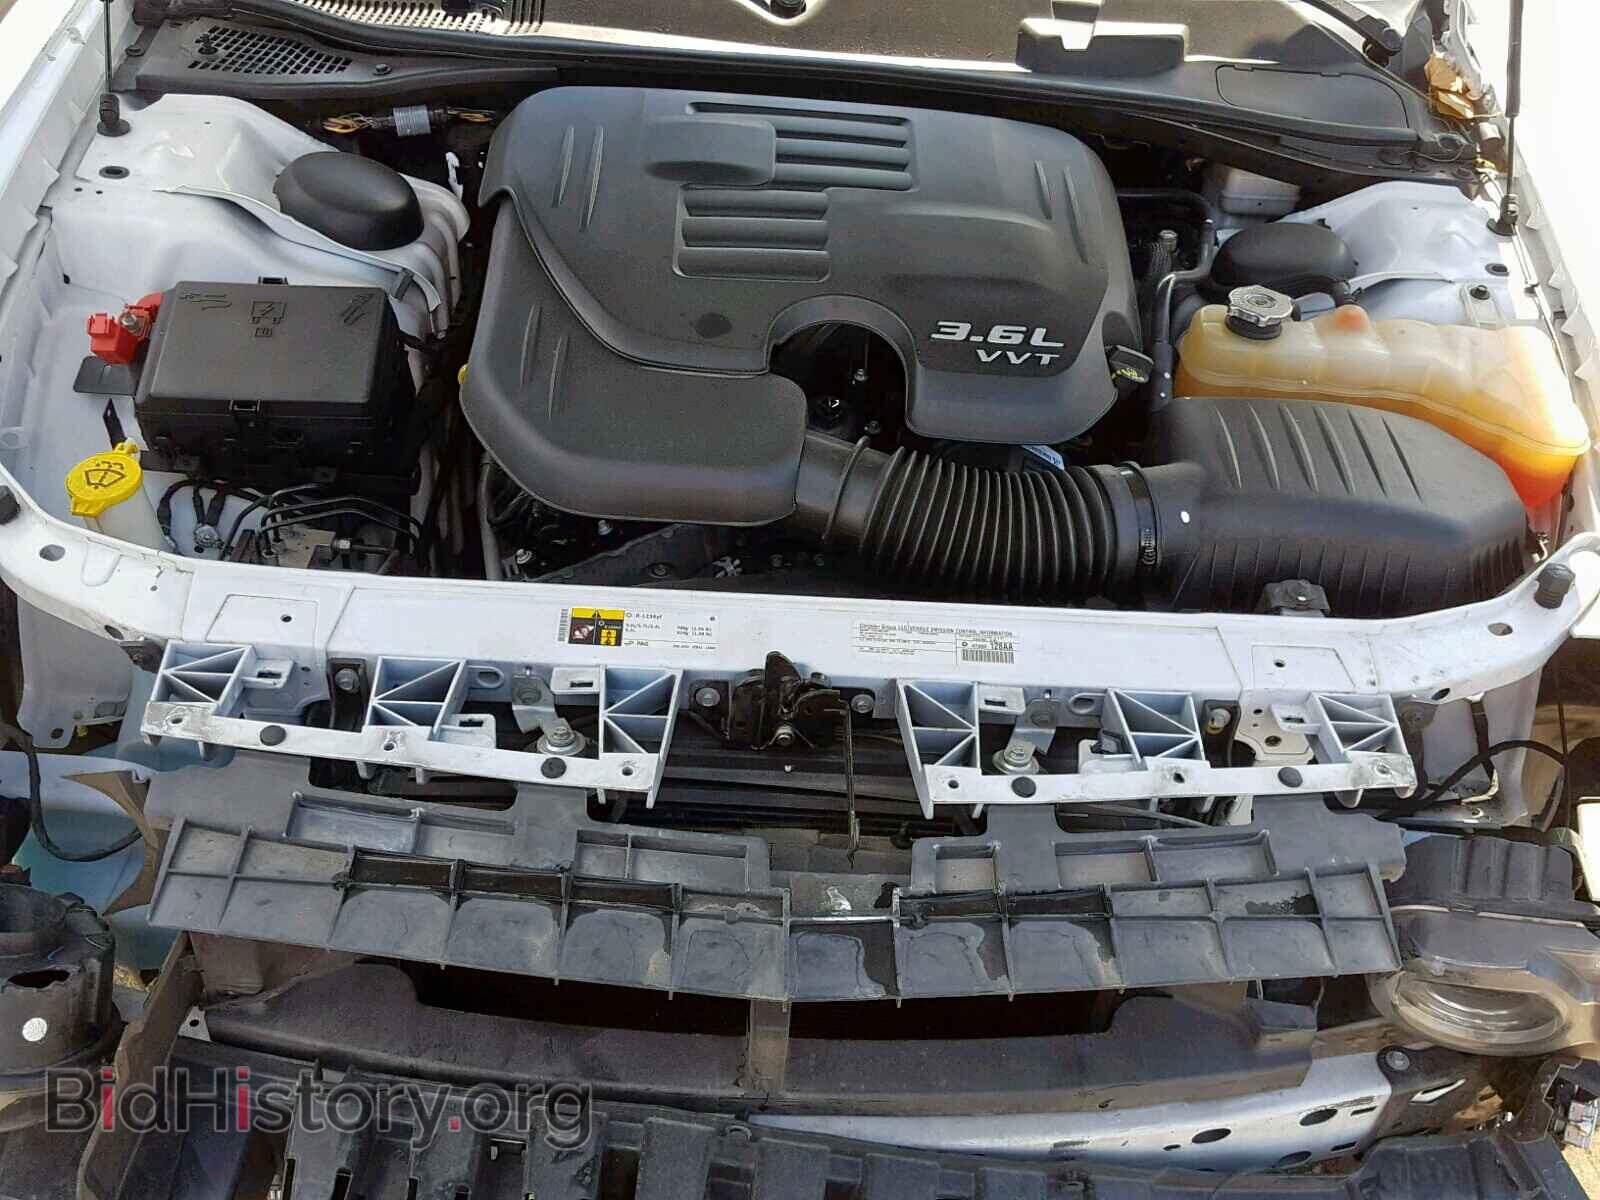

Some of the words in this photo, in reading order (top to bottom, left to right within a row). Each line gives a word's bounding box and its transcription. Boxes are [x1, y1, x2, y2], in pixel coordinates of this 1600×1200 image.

[930, 320, 1065, 348] 3.6L
[976, 348, 1061, 366] VVT
[991, 641, 1014, 651] 128AA
